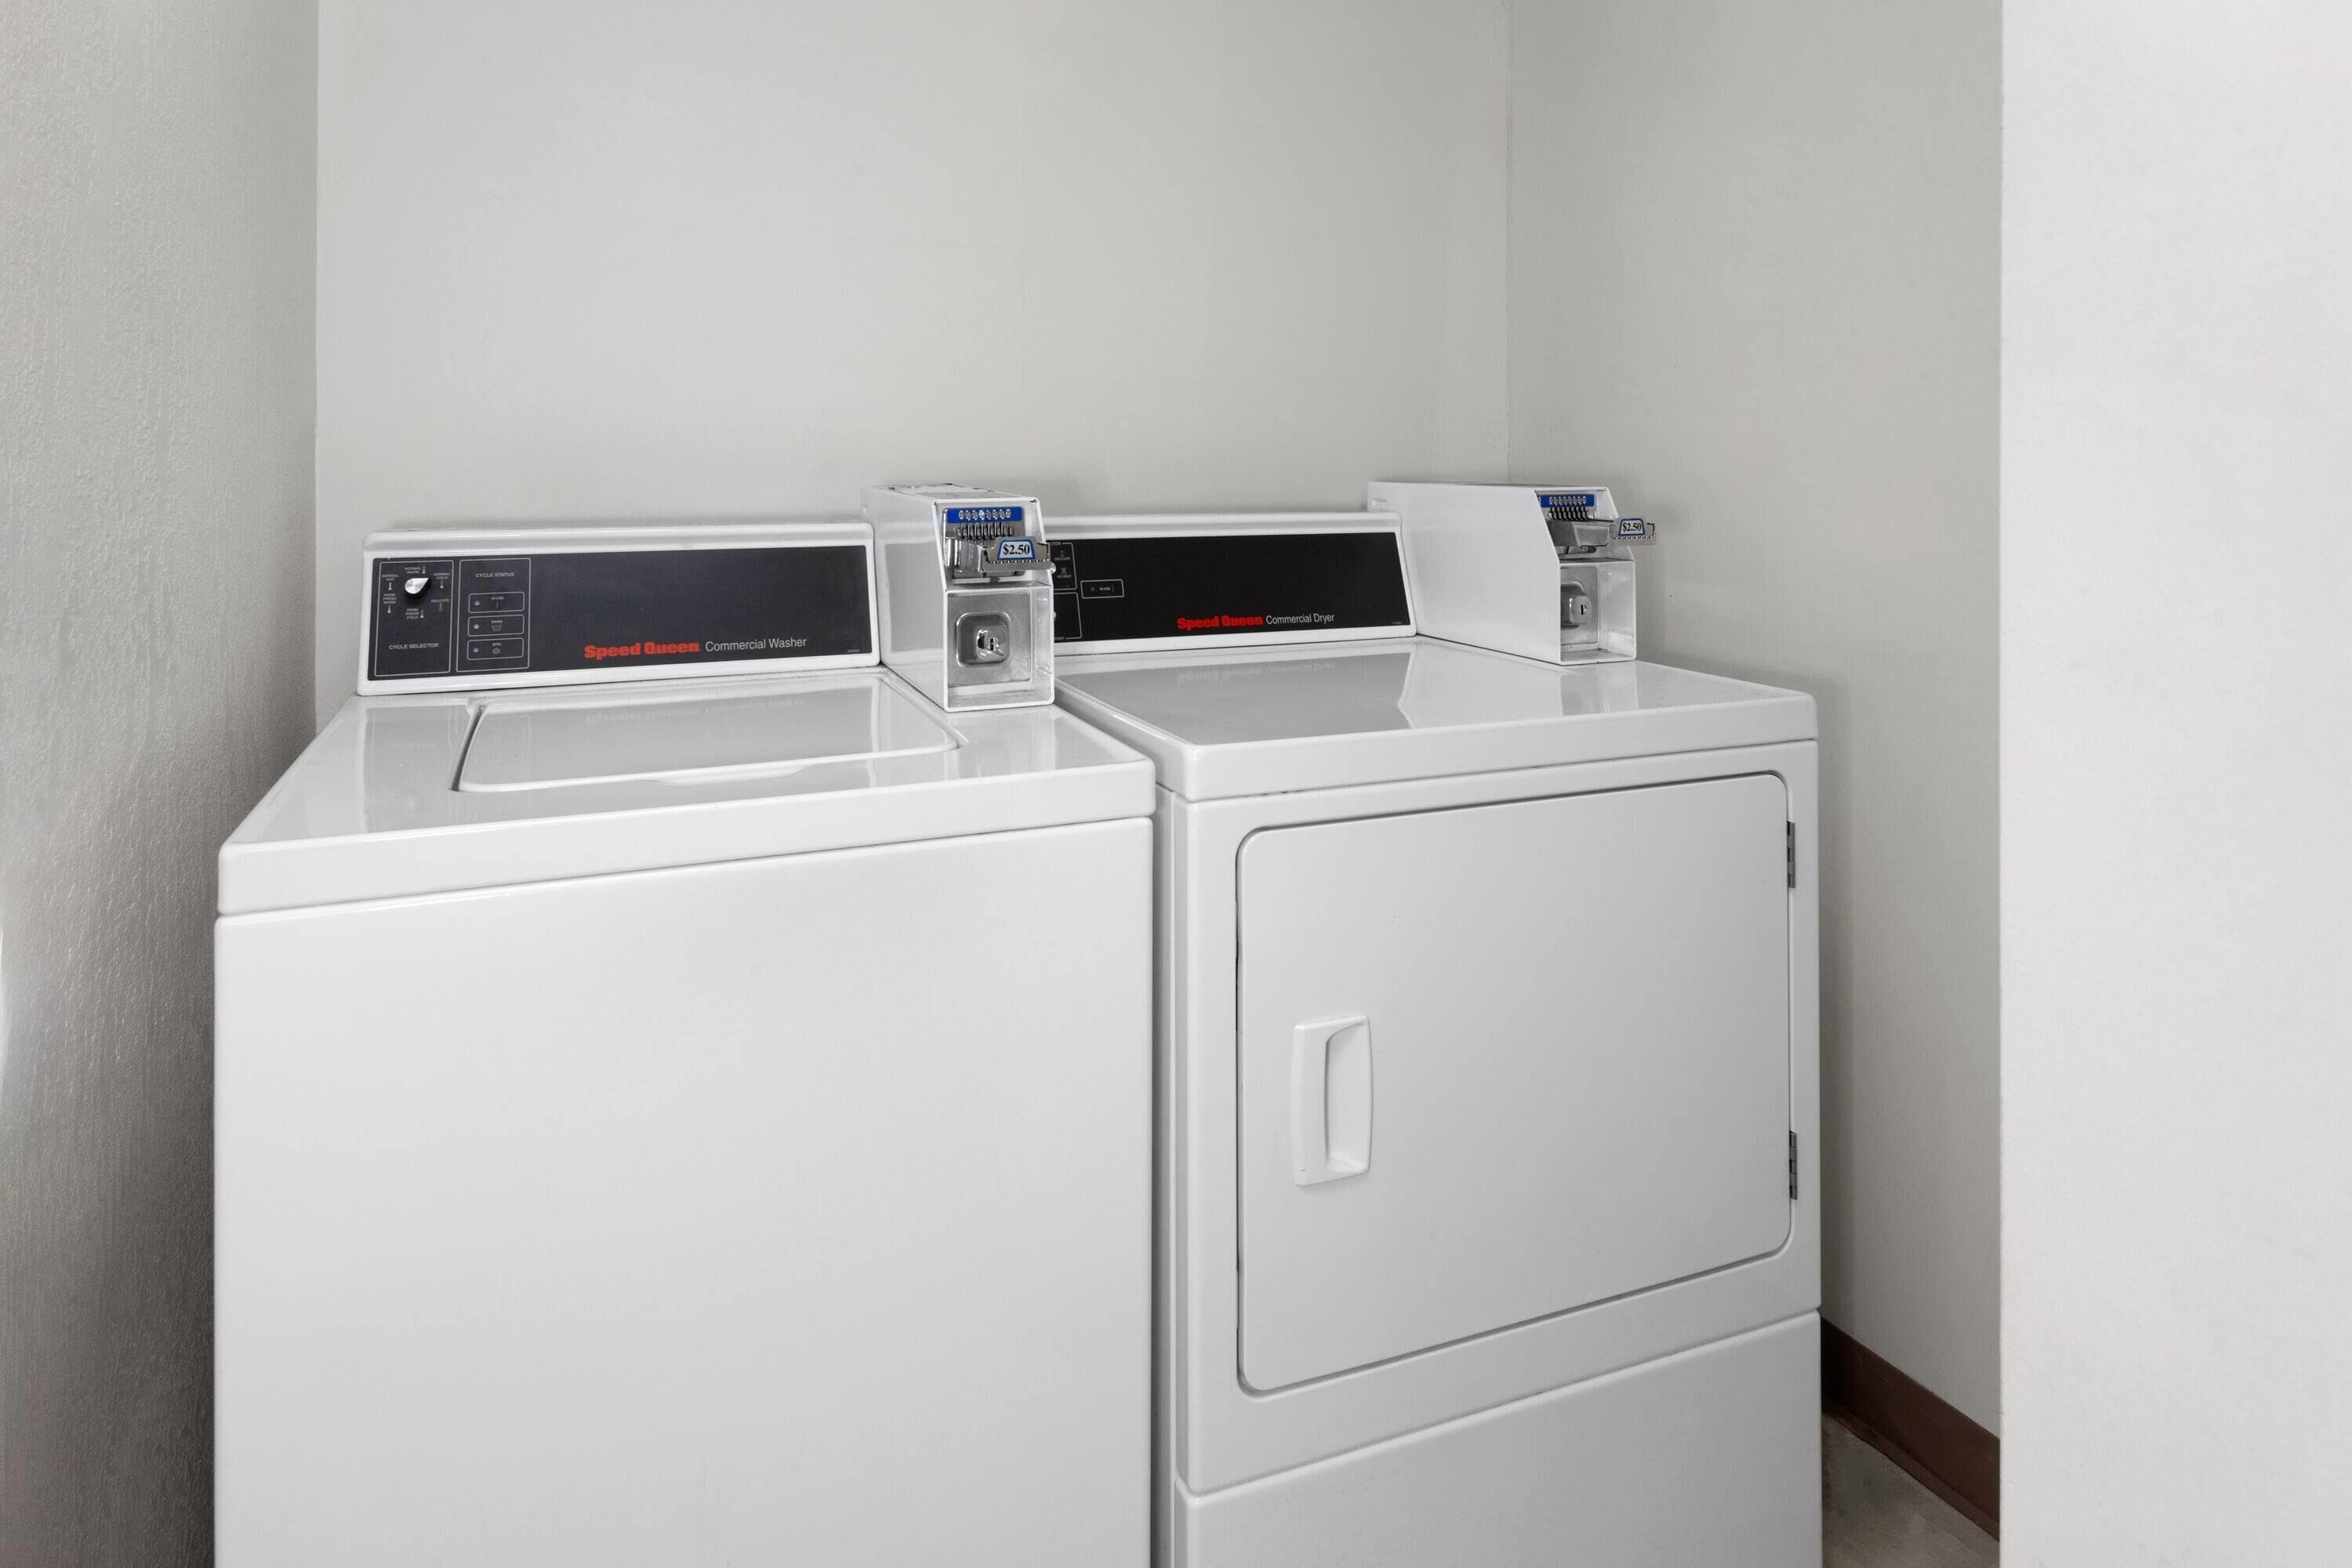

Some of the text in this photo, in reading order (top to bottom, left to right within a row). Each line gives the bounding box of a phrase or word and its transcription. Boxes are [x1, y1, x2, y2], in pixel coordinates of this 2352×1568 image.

[1622, 521, 1642, 532] $2.50
[1003, 543, 1030, 555] $2.50
[1177, 613, 1335, 631] Speed Queen Commercial Dryer
[584, 637, 808, 661] Speed Queen Commercial Washer
